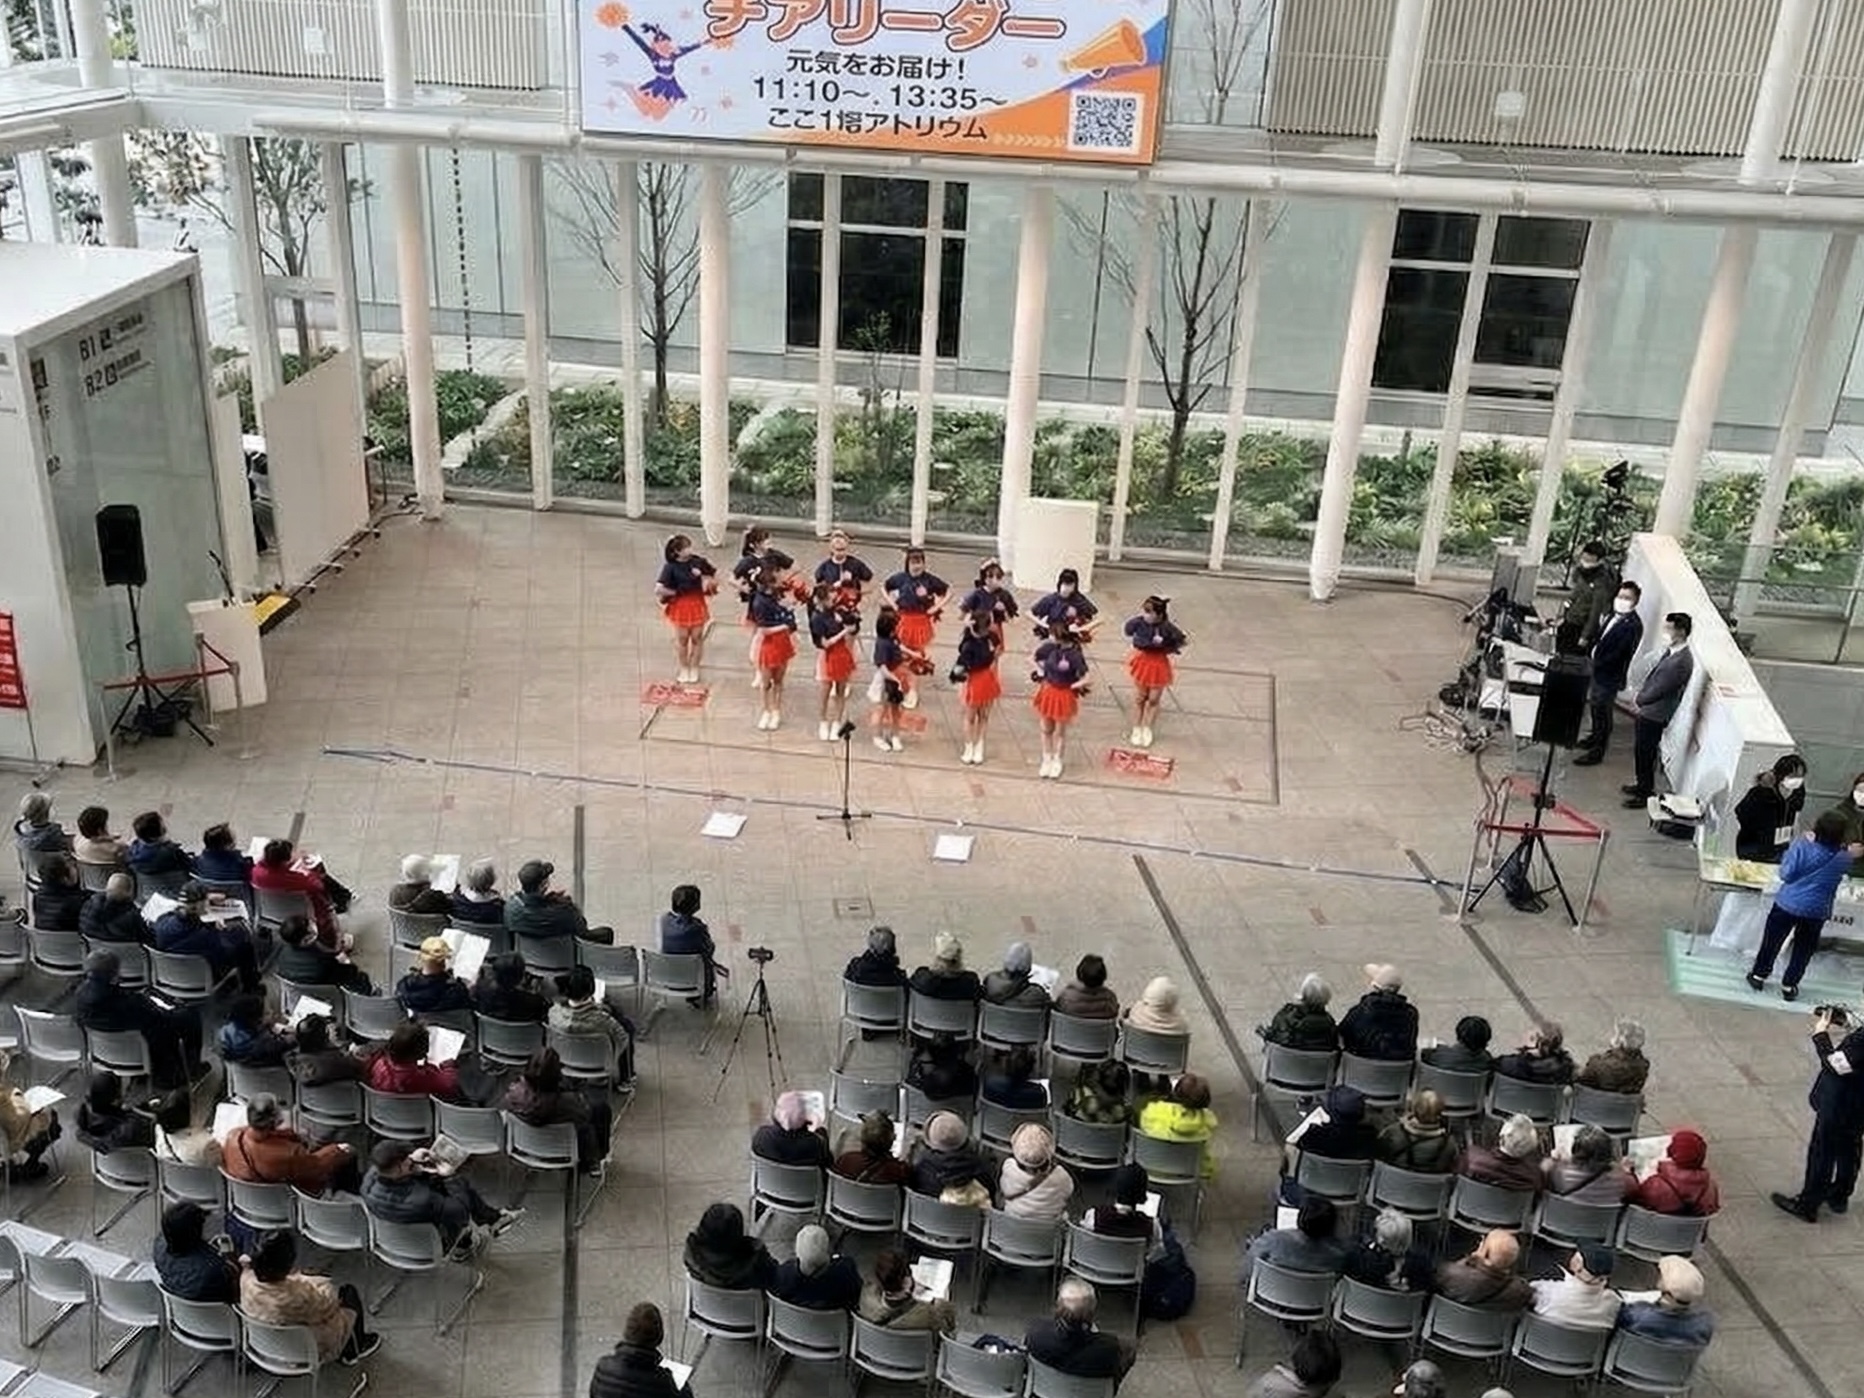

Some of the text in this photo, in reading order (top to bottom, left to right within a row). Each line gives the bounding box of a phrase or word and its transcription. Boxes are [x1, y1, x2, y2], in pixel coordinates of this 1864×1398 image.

[704, 0, 1066, 51] チアリーダー
